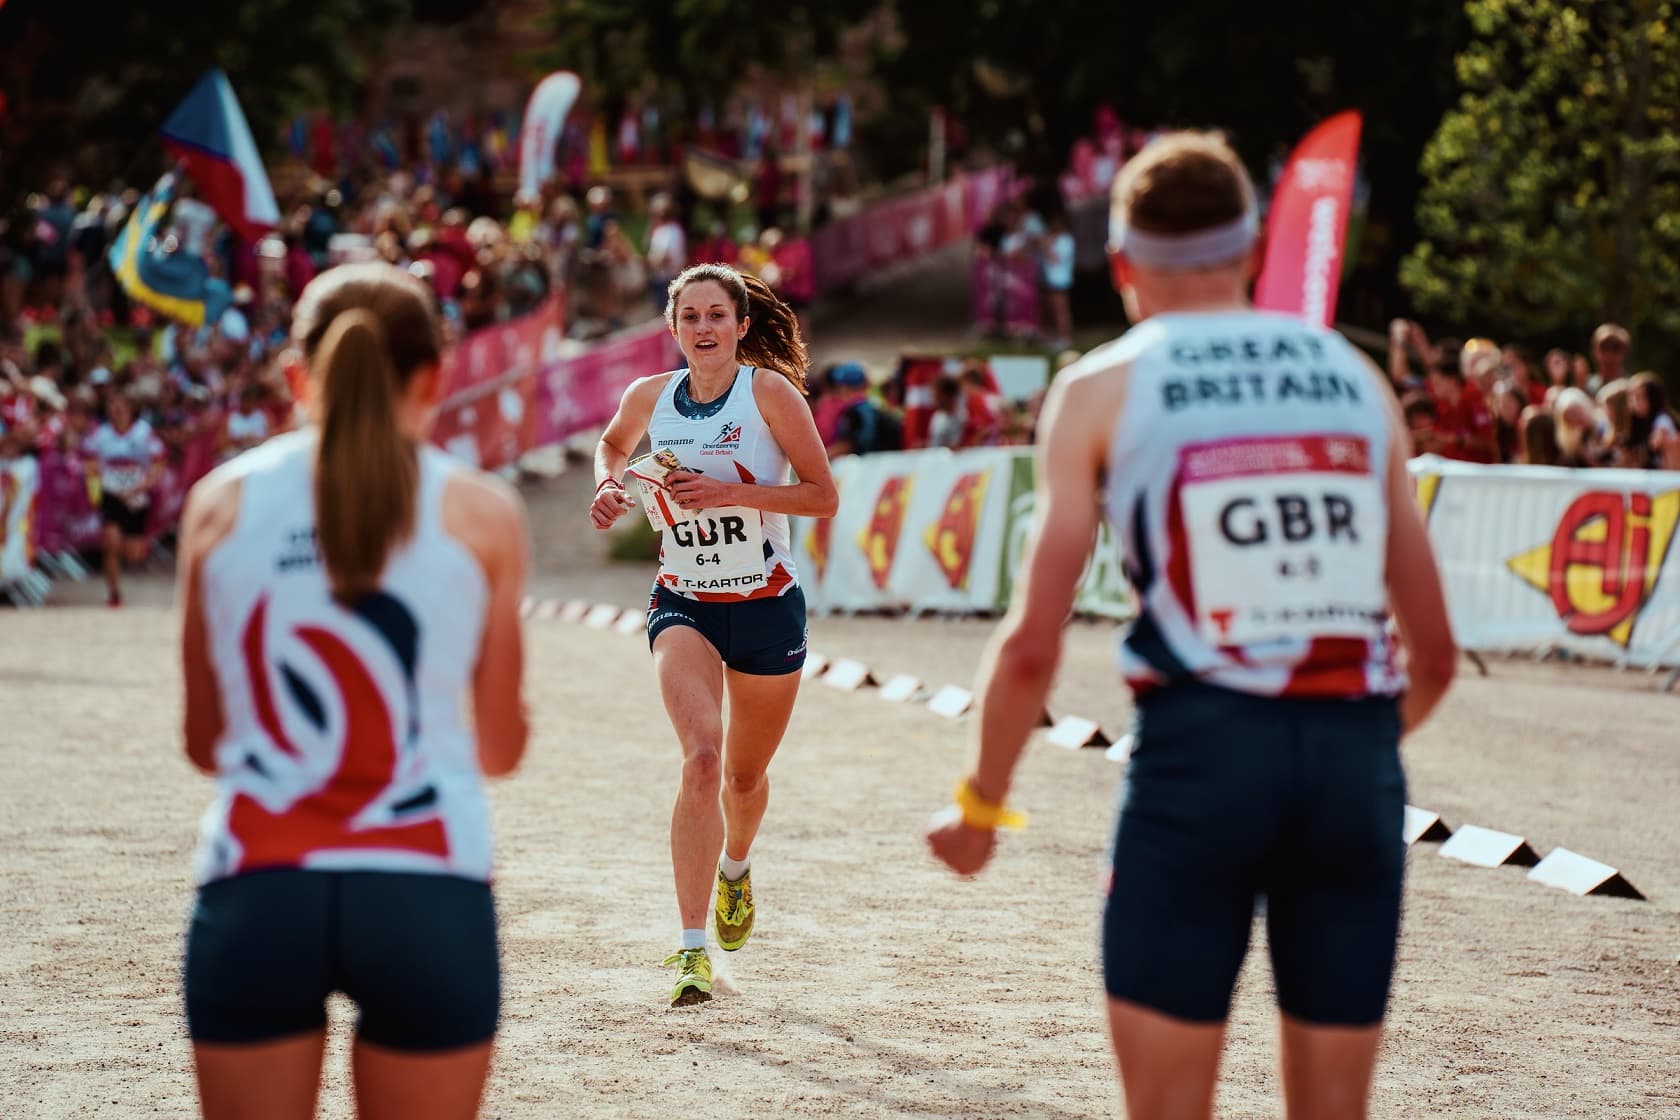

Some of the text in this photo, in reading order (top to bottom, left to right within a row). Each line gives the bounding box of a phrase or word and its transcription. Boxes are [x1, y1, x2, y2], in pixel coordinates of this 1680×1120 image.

[1161, 373, 1362, 410] BRITAIN
[1219, 494, 1358, 546] GBR
[696, 553, 721, 566] 6-4
[683, 573, 763, 589] T-KARTOR
